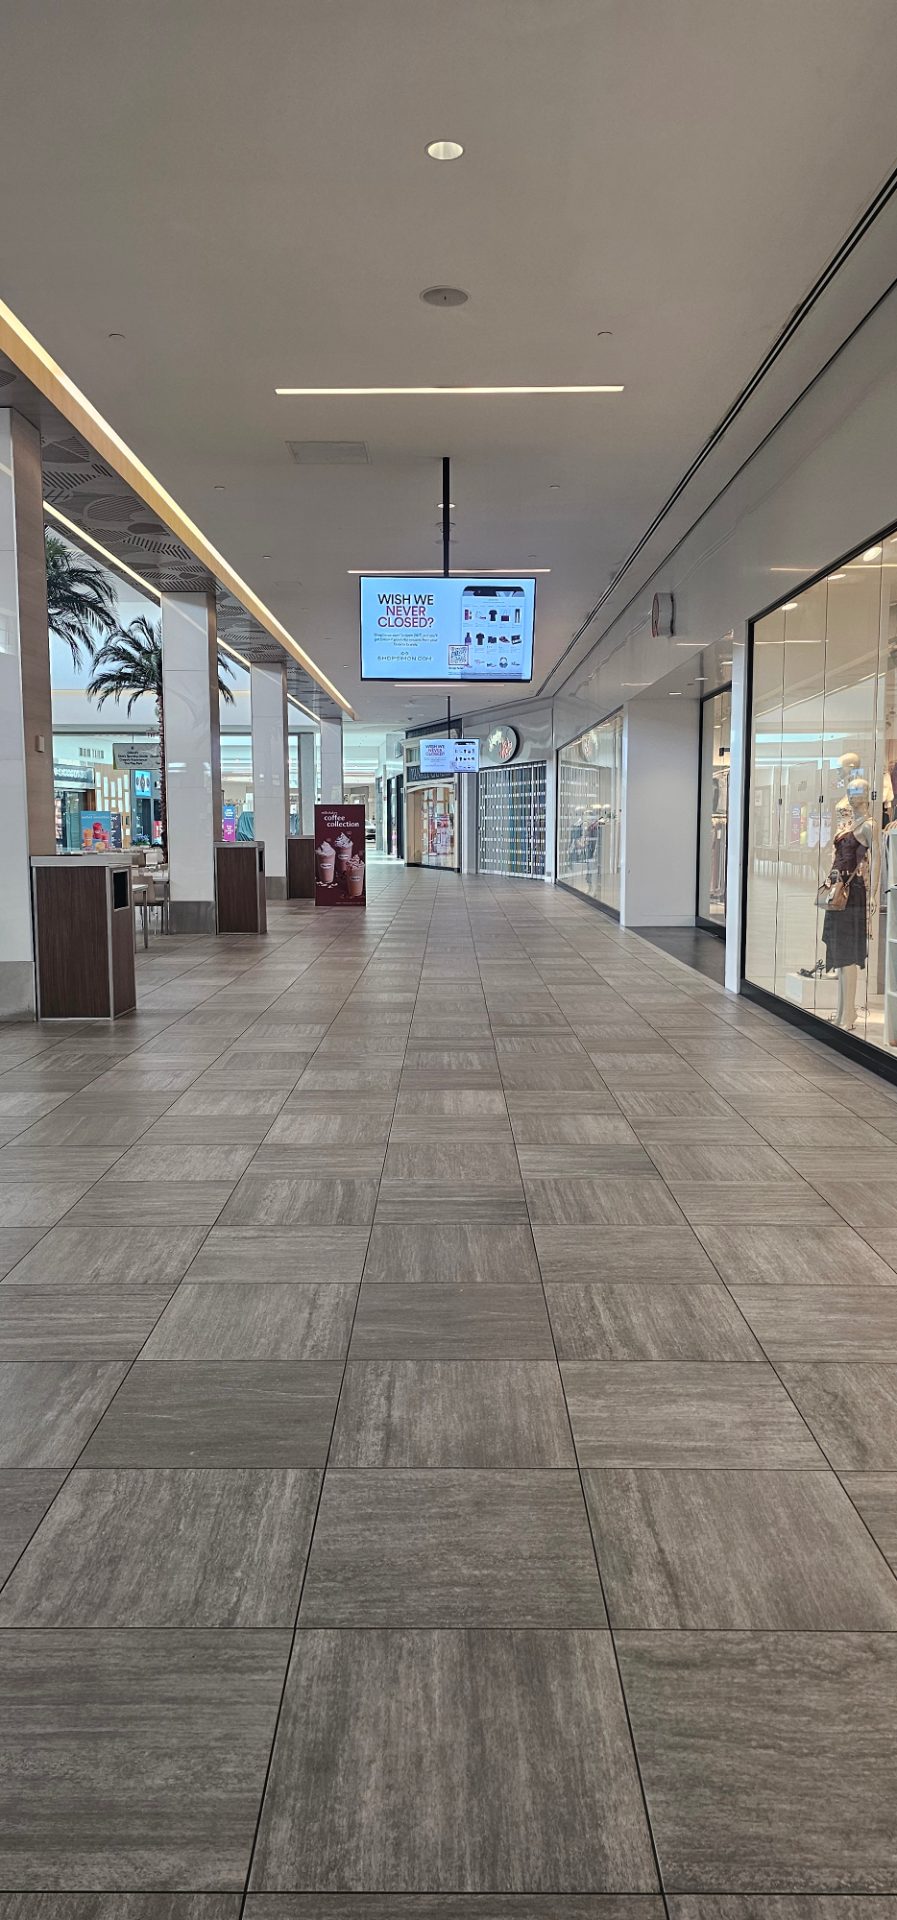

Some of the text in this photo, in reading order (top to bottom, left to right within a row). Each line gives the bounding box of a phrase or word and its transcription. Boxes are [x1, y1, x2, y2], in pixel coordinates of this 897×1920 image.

[377, 593, 434, 606] WISH WE
[386, 605, 427, 617] NEVER
[377, 616, 434, 628] CLOSED?
[326, 820, 360, 828] collection
